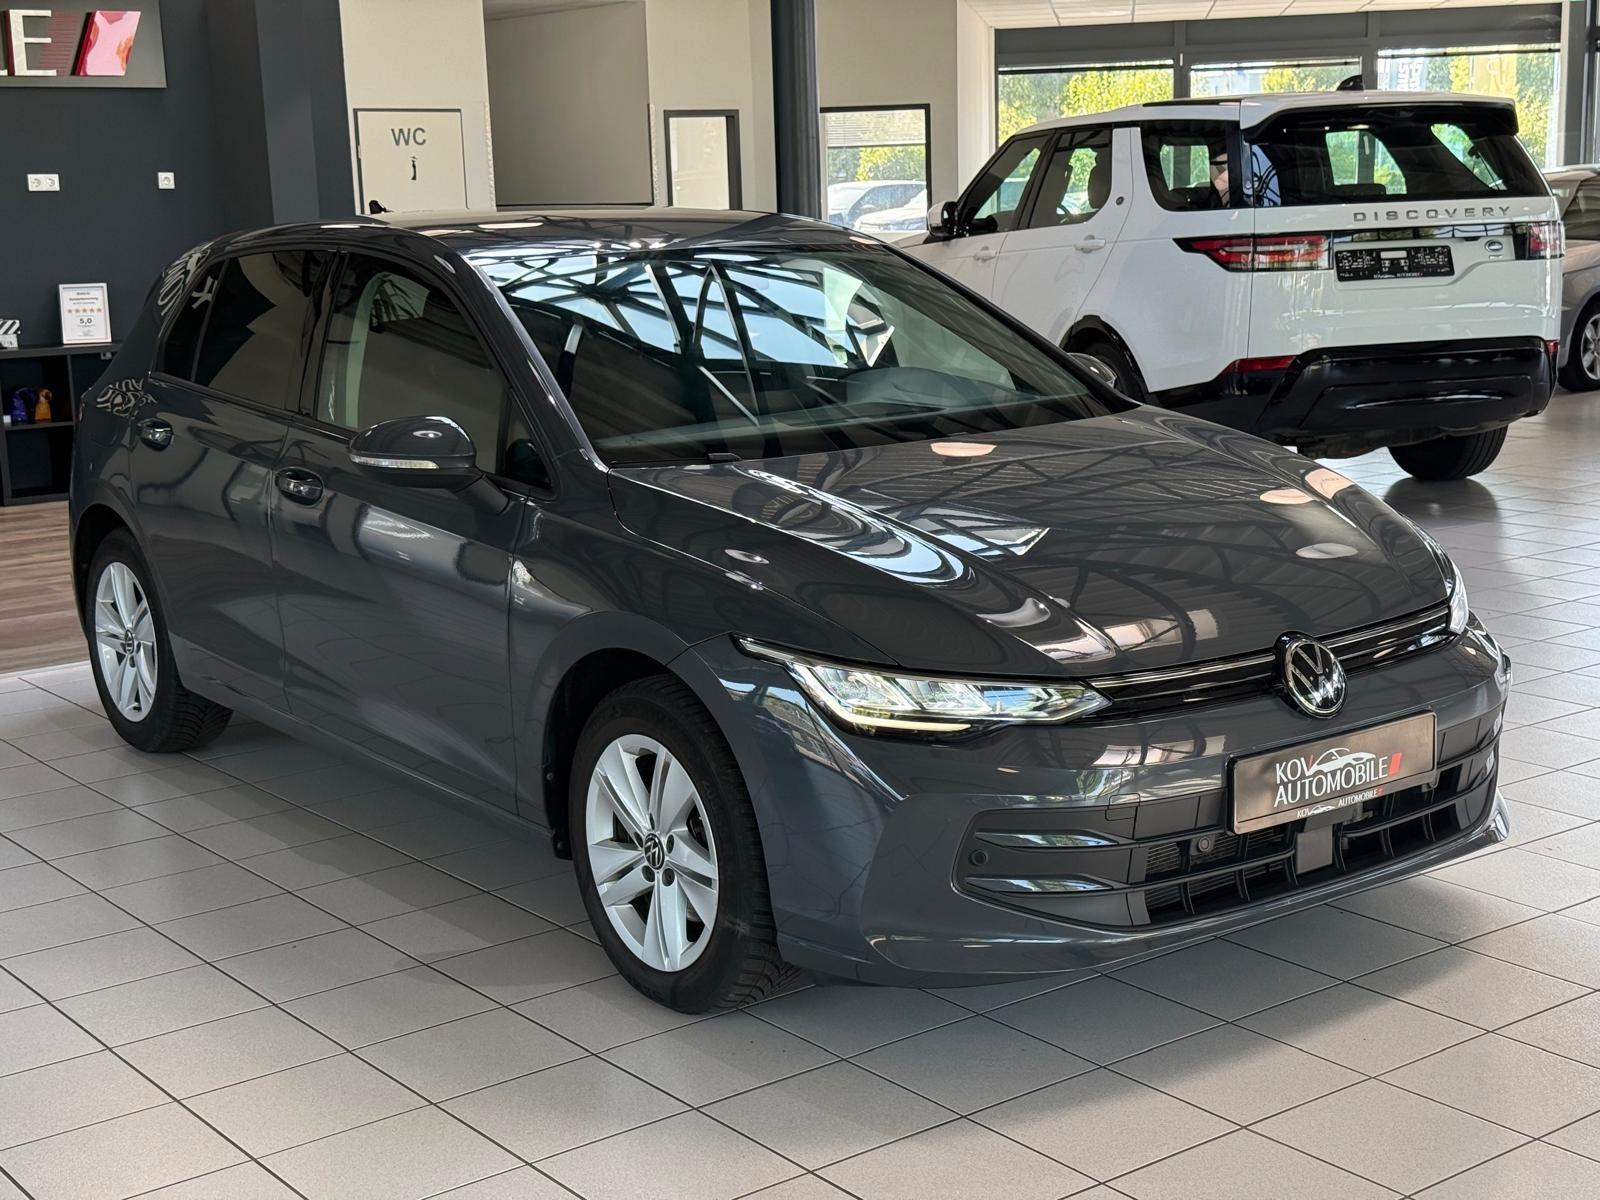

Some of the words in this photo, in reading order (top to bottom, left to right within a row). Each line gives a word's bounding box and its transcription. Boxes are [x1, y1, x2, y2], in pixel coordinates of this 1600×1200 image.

[390, 127, 427, 147] WC
[1352, 206, 1511, 223] DISCOVERY
[1276, 754, 1315, 784] KOV
[1274, 756, 1388, 808] AUTOMOBILE
[1338, 788, 1379, 807] AUTOMOBILE
